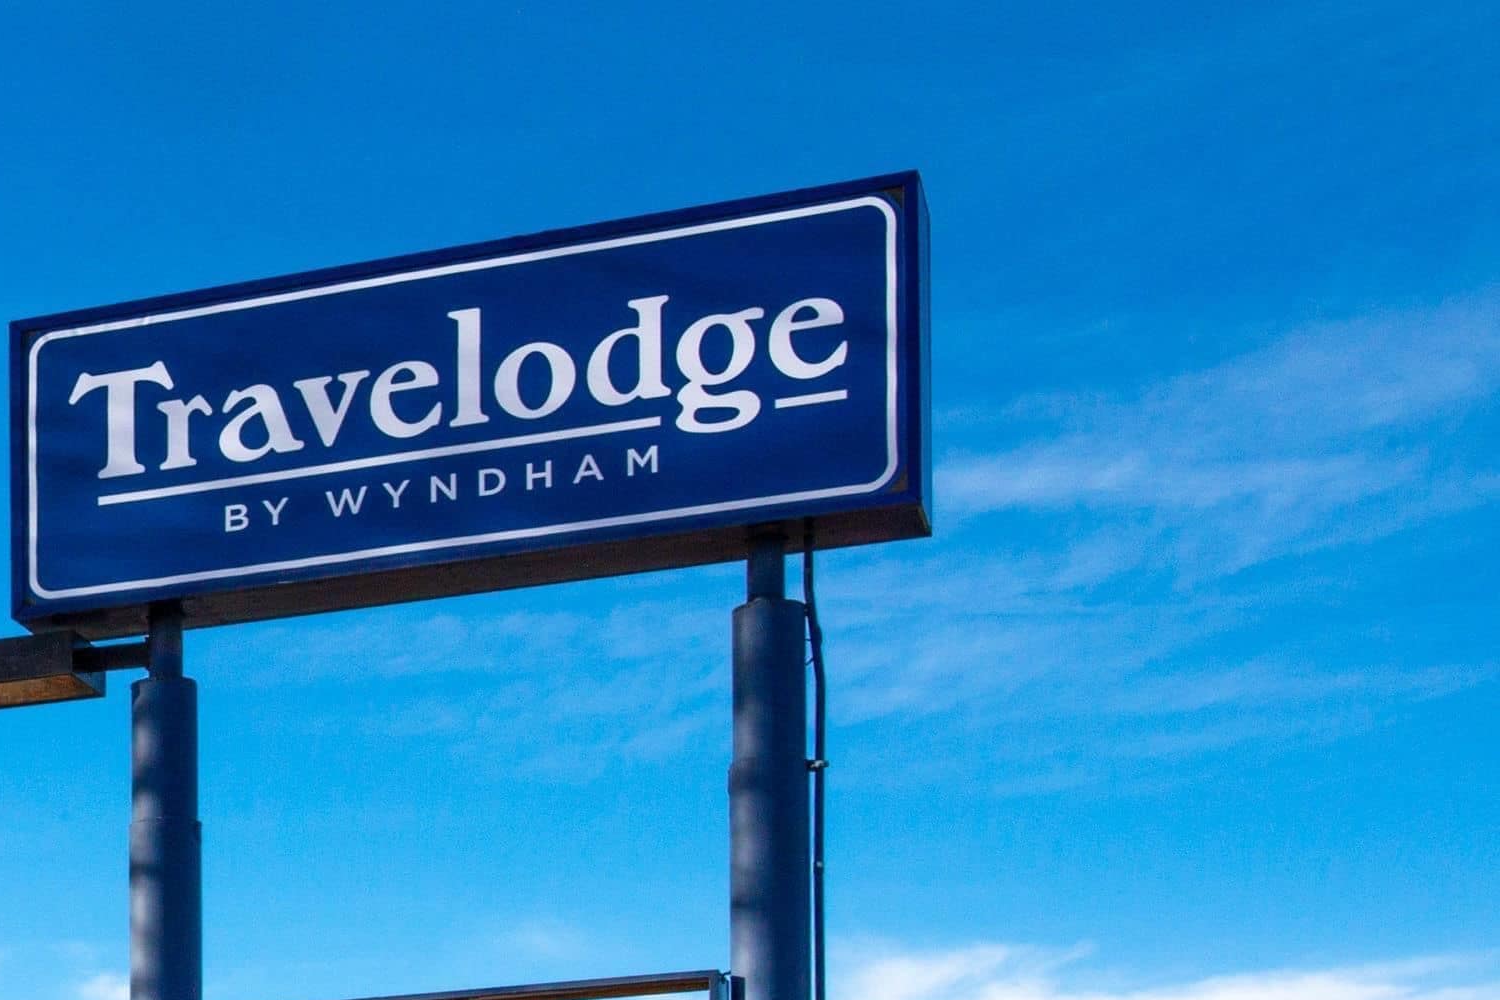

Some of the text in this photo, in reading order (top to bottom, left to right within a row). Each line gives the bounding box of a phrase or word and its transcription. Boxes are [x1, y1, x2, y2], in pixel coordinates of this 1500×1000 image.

[69, 294, 848, 479] Travelodge
[224, 445, 659, 533] BY WYNDHAM
